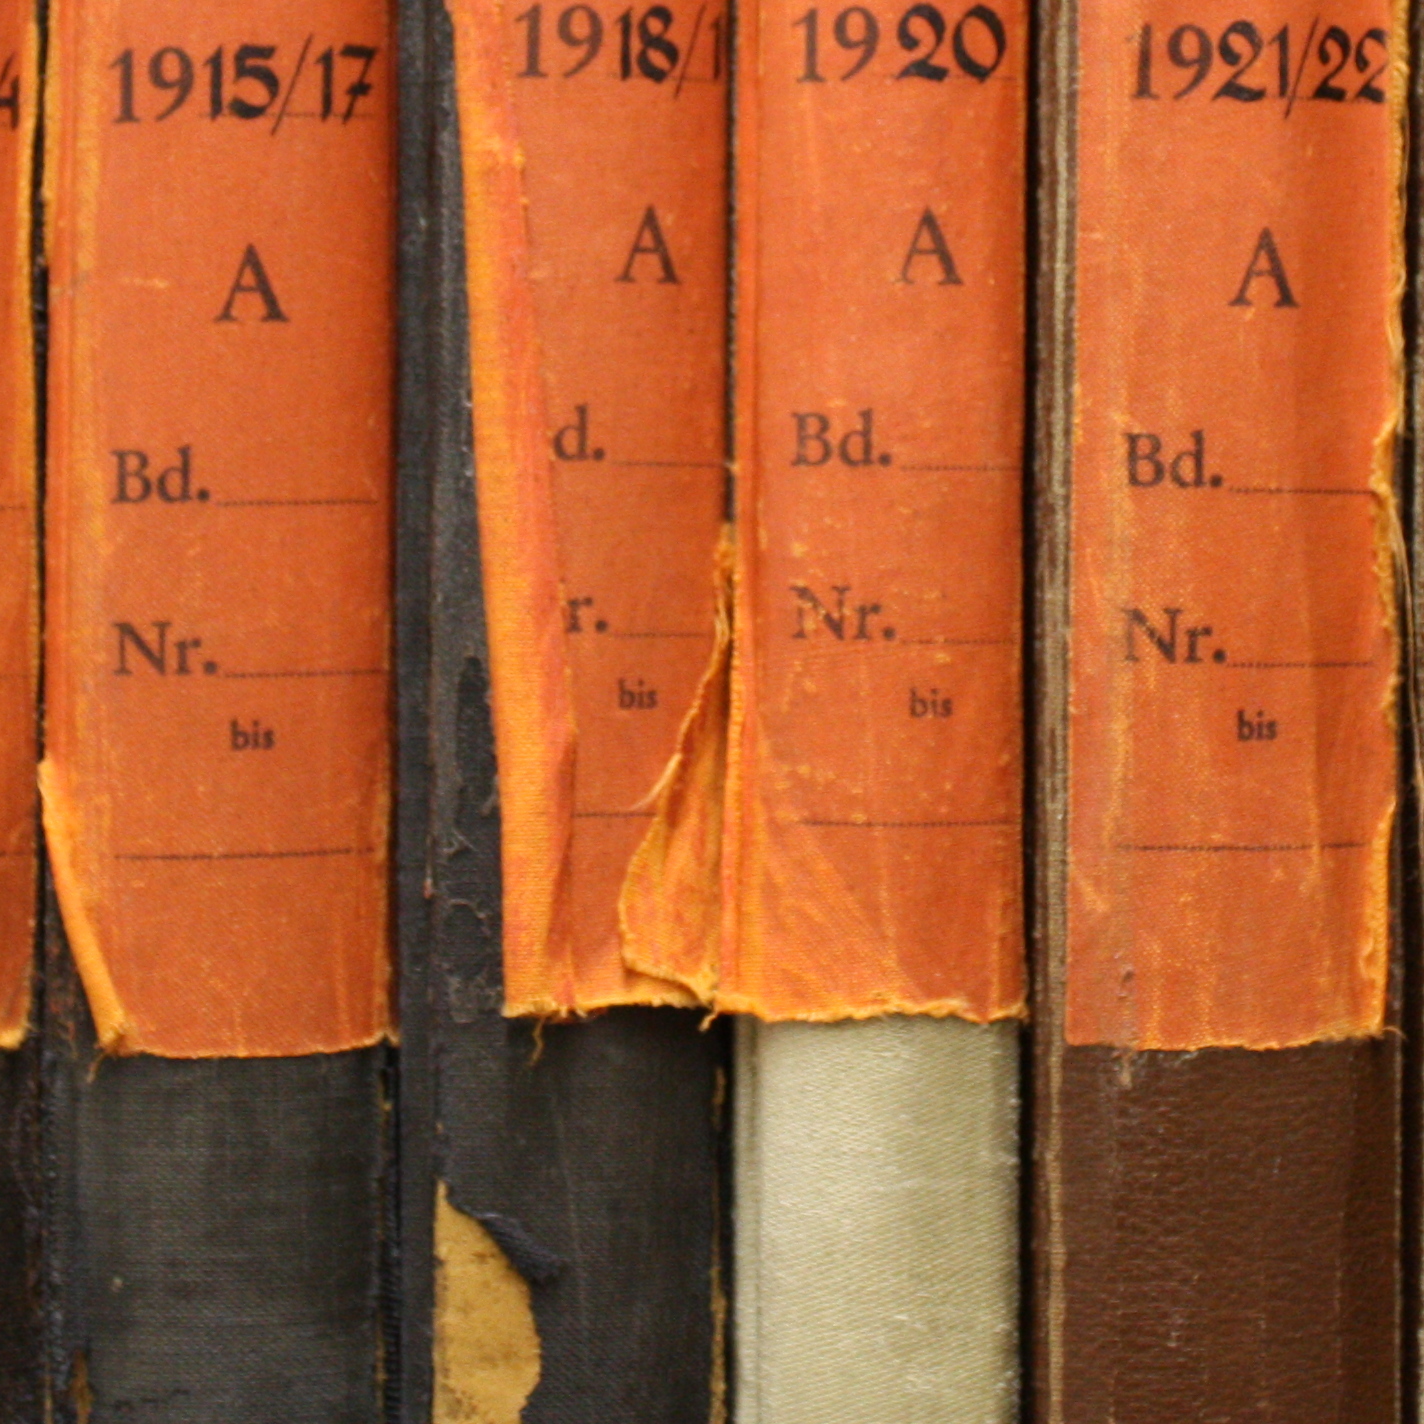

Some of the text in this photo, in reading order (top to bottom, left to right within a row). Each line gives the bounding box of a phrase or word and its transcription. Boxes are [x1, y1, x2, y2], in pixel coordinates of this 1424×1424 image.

[792, 2, 1007, 84] 1920
[1127, 16, 1388, 120] 1921/22
[109, 33, 377, 137] 1915/17
[615, 203, 681, 285] A
[895, 206, 965, 287] A
[1228, 227, 1300, 308] A
[214, 243, 290, 324] A
[552, 403, 606, 463] d.
[790, 408, 893, 468] Bd.
[1125, 430, 1223, 490] Bd.
[110, 444, 211, 505] Bd.
[563, 595, 609, 634] r.
[790, 584, 896, 642] Nr.
[1123, 607, 1226, 665] Nr.
[112, 621, 218, 677] Nr.
[618, 680, 658, 710] bis
[909, 687, 953, 719] bis
[229, 719, 275, 750] bis
[1237, 711, 1278, 742] bis
